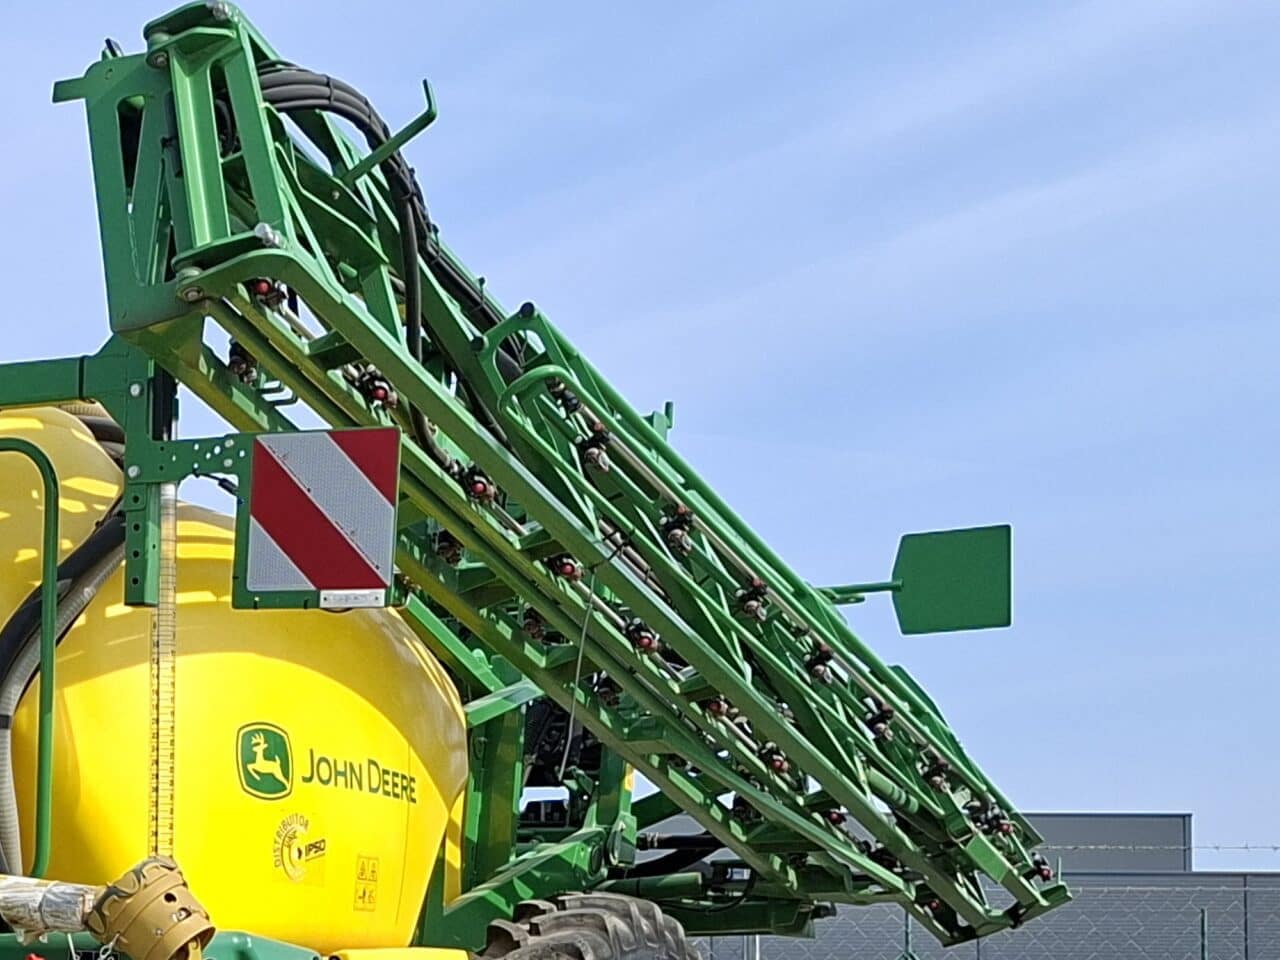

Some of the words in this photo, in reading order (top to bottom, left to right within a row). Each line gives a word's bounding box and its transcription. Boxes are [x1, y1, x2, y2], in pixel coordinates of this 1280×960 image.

[301, 748, 363, 792] JOHN
[367, 758, 417, 804] DEERE
[304, 838, 327, 858] IPSO
